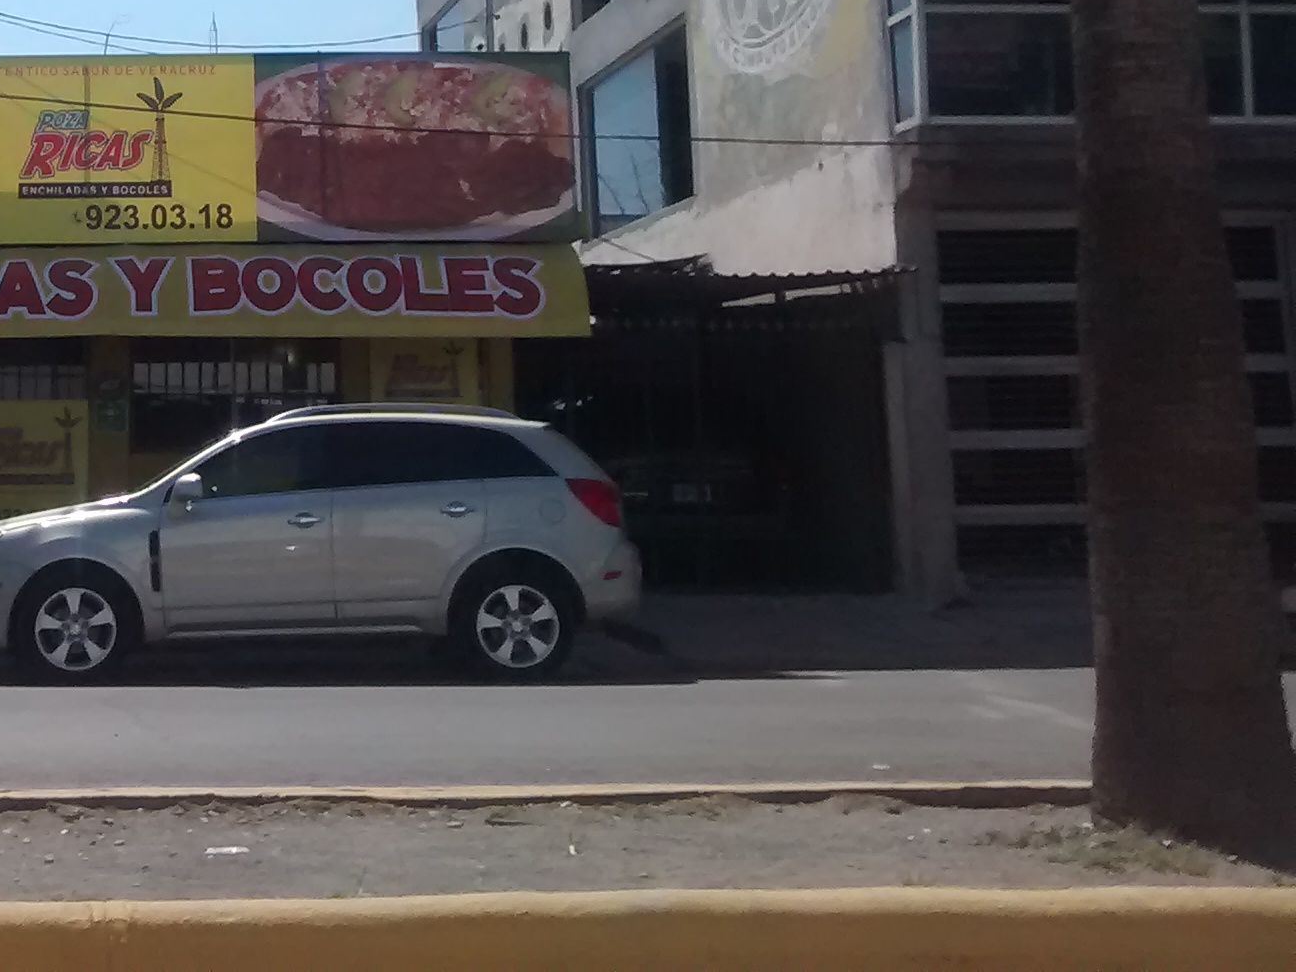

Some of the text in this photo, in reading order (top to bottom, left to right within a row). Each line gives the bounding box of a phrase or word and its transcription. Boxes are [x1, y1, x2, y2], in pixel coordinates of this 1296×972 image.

[62, 65, 110, 77] SABOR
[114, 64, 134, 76] DE
[139, 64, 217, 76] VERACRUZ
[35, 109, 90, 132] POZA
[19, 130, 154, 179] RICAS
[22, 184, 169, 196] ENCHILADAS Y BOCOLES
[85, 204, 234, 230] 923.03.18
[108, 256, 177, 316] Y
[187, 254, 546, 320] BOCOLES
